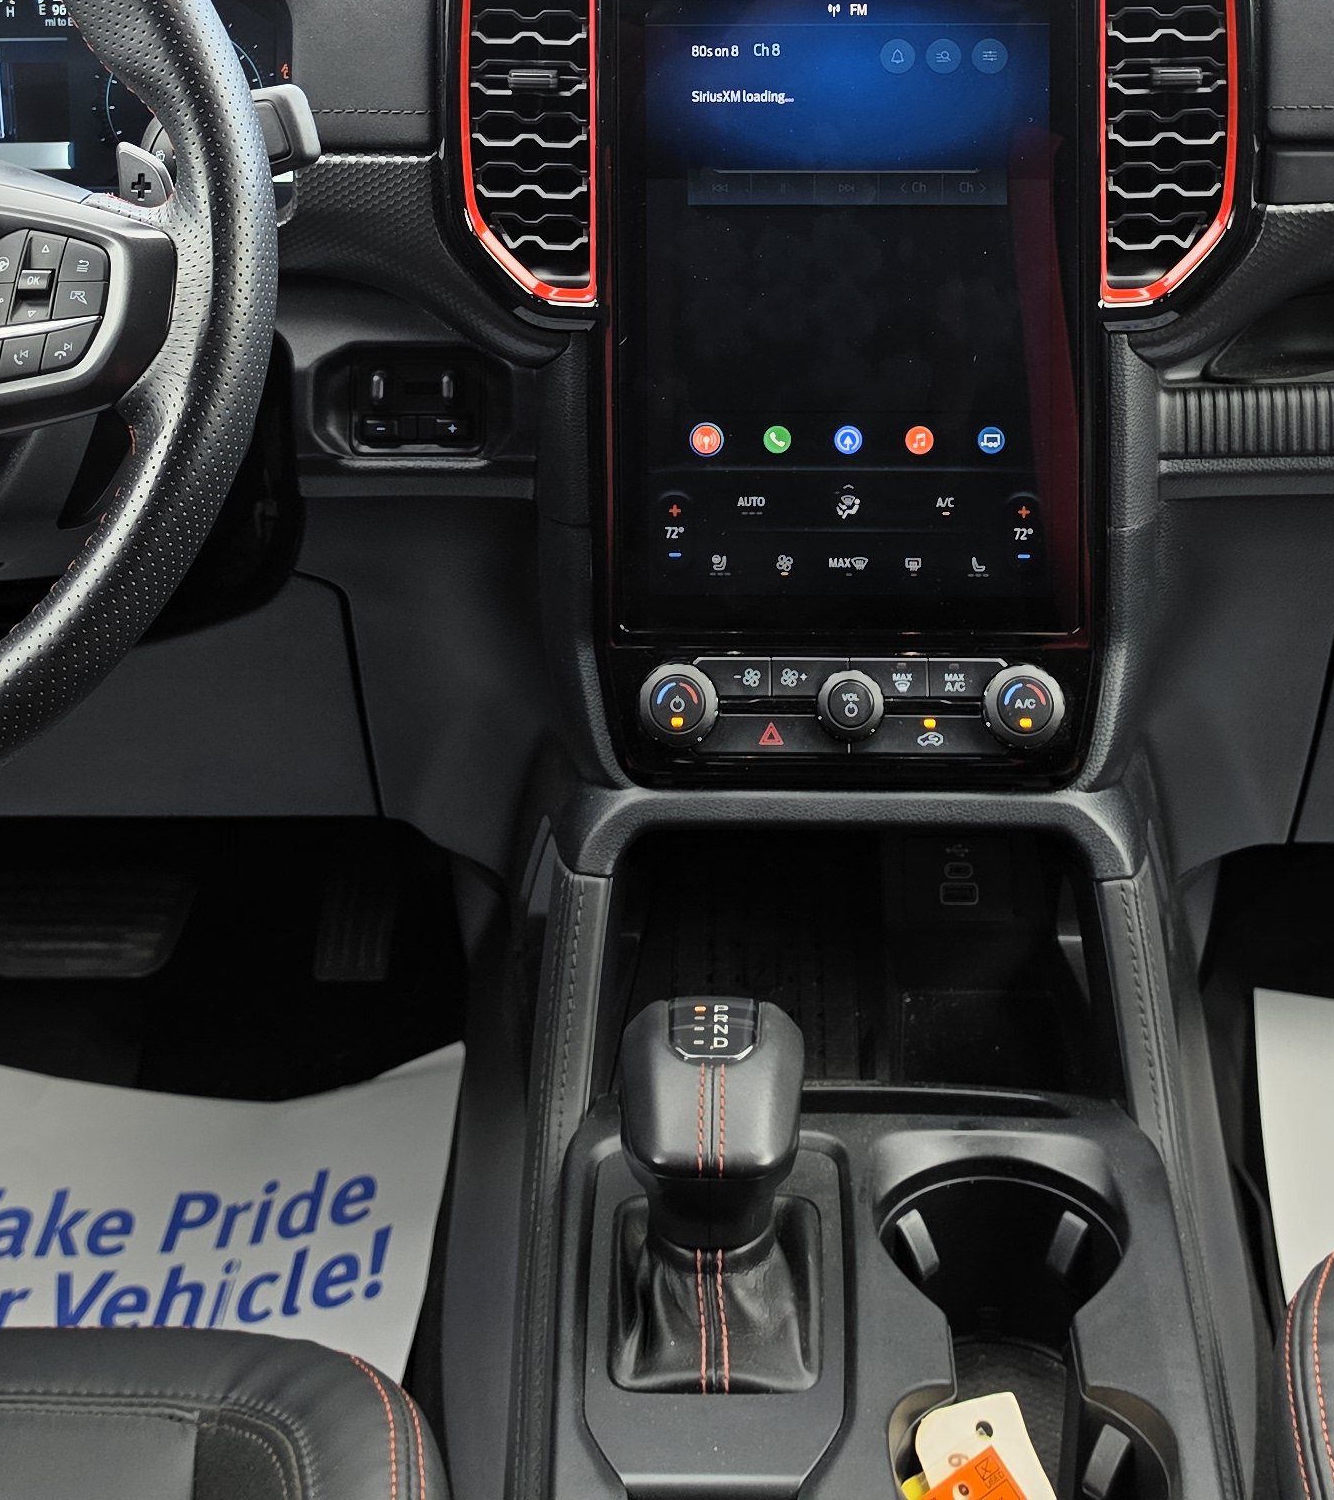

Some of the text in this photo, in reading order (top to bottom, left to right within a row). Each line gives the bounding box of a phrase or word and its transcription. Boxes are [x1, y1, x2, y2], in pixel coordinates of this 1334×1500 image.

[5, 6, 15, 18] H
[38, 4, 47, 16] E
[849, 3, 868, 17] FM
[690, 44, 740, 58] 80s on 8
[753, 43, 781, 57] Ch 8
[690, 90, 741, 104] SiriusXM
[26, 275, 40, 287] OK
[736, 495, 766, 509] AUTO
[935, 495, 955, 509] A/C
[828, 556, 852, 570] MAX
[891, 672, 913, 682] MAX
[943, 672, 966, 683] MAX
[943, 680, 968, 694] A/C
[840, 693, 861, 702] VOL
[1014, 697, 1037, 711] A/C
[713, 1004, 729, 1014] P
[713, 1013, 729, 1024] R
[713, 1024, 729, 1035] N
[713, 1037, 729, 1049] D
[157, 1166, 381, 1257] Pride
[52, 1224, 394, 1329] Vehicle!
